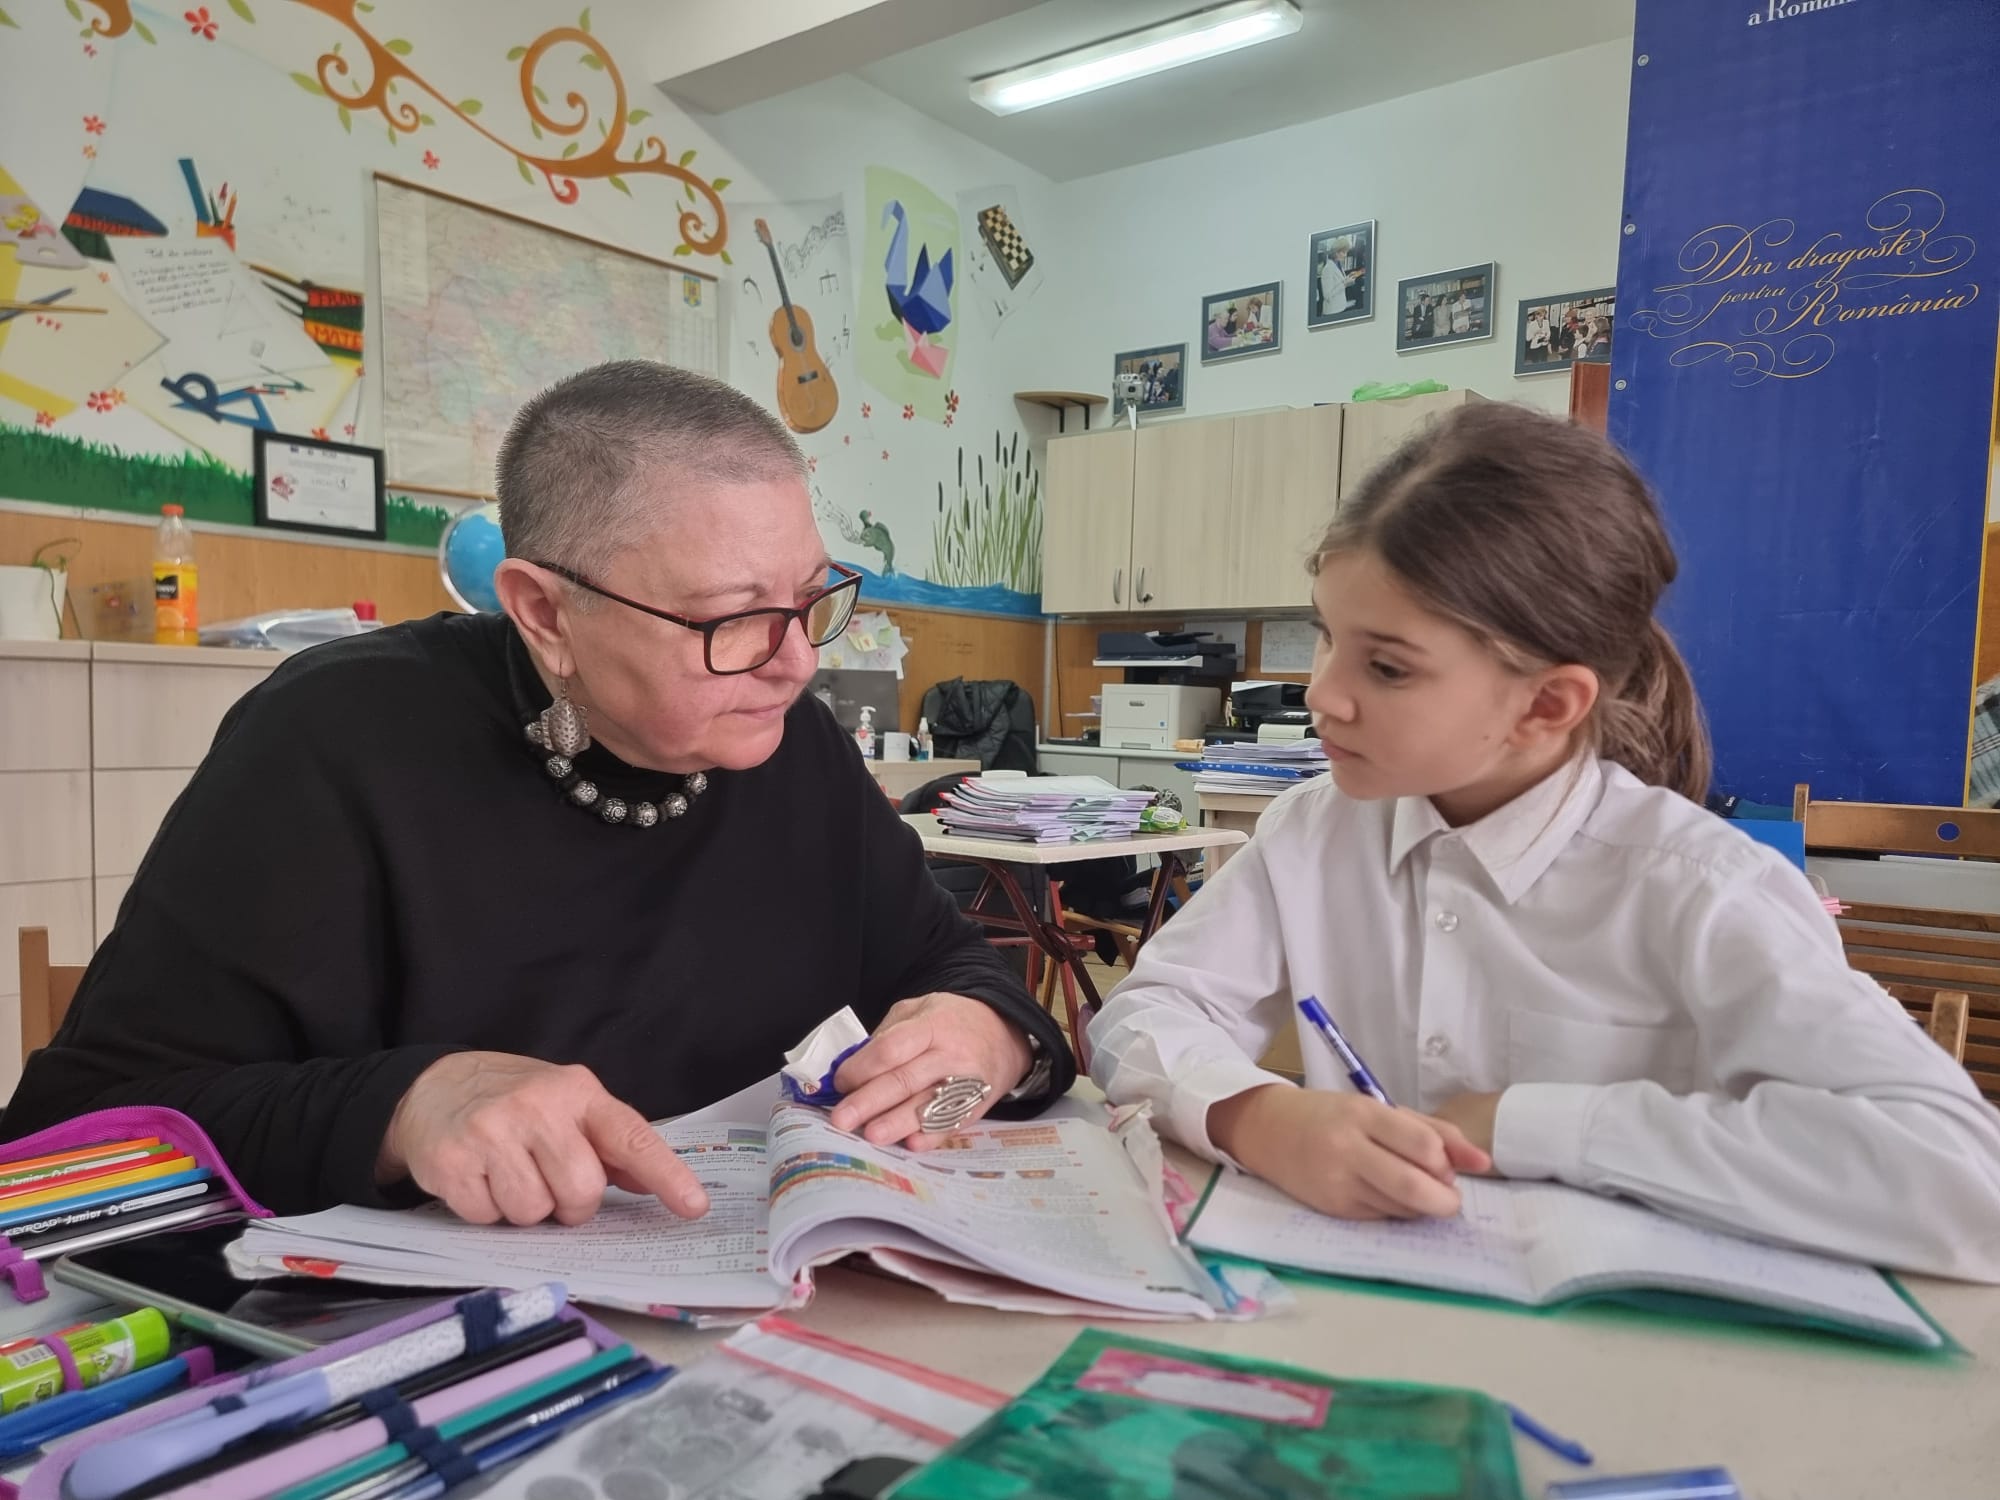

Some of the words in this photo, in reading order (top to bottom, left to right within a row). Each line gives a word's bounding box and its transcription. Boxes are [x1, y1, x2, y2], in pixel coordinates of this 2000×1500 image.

[1747, 12, 1762, 26] a
[1756, 279, 1979, 335] România
[65, 1209, 102, 1225] Junior
